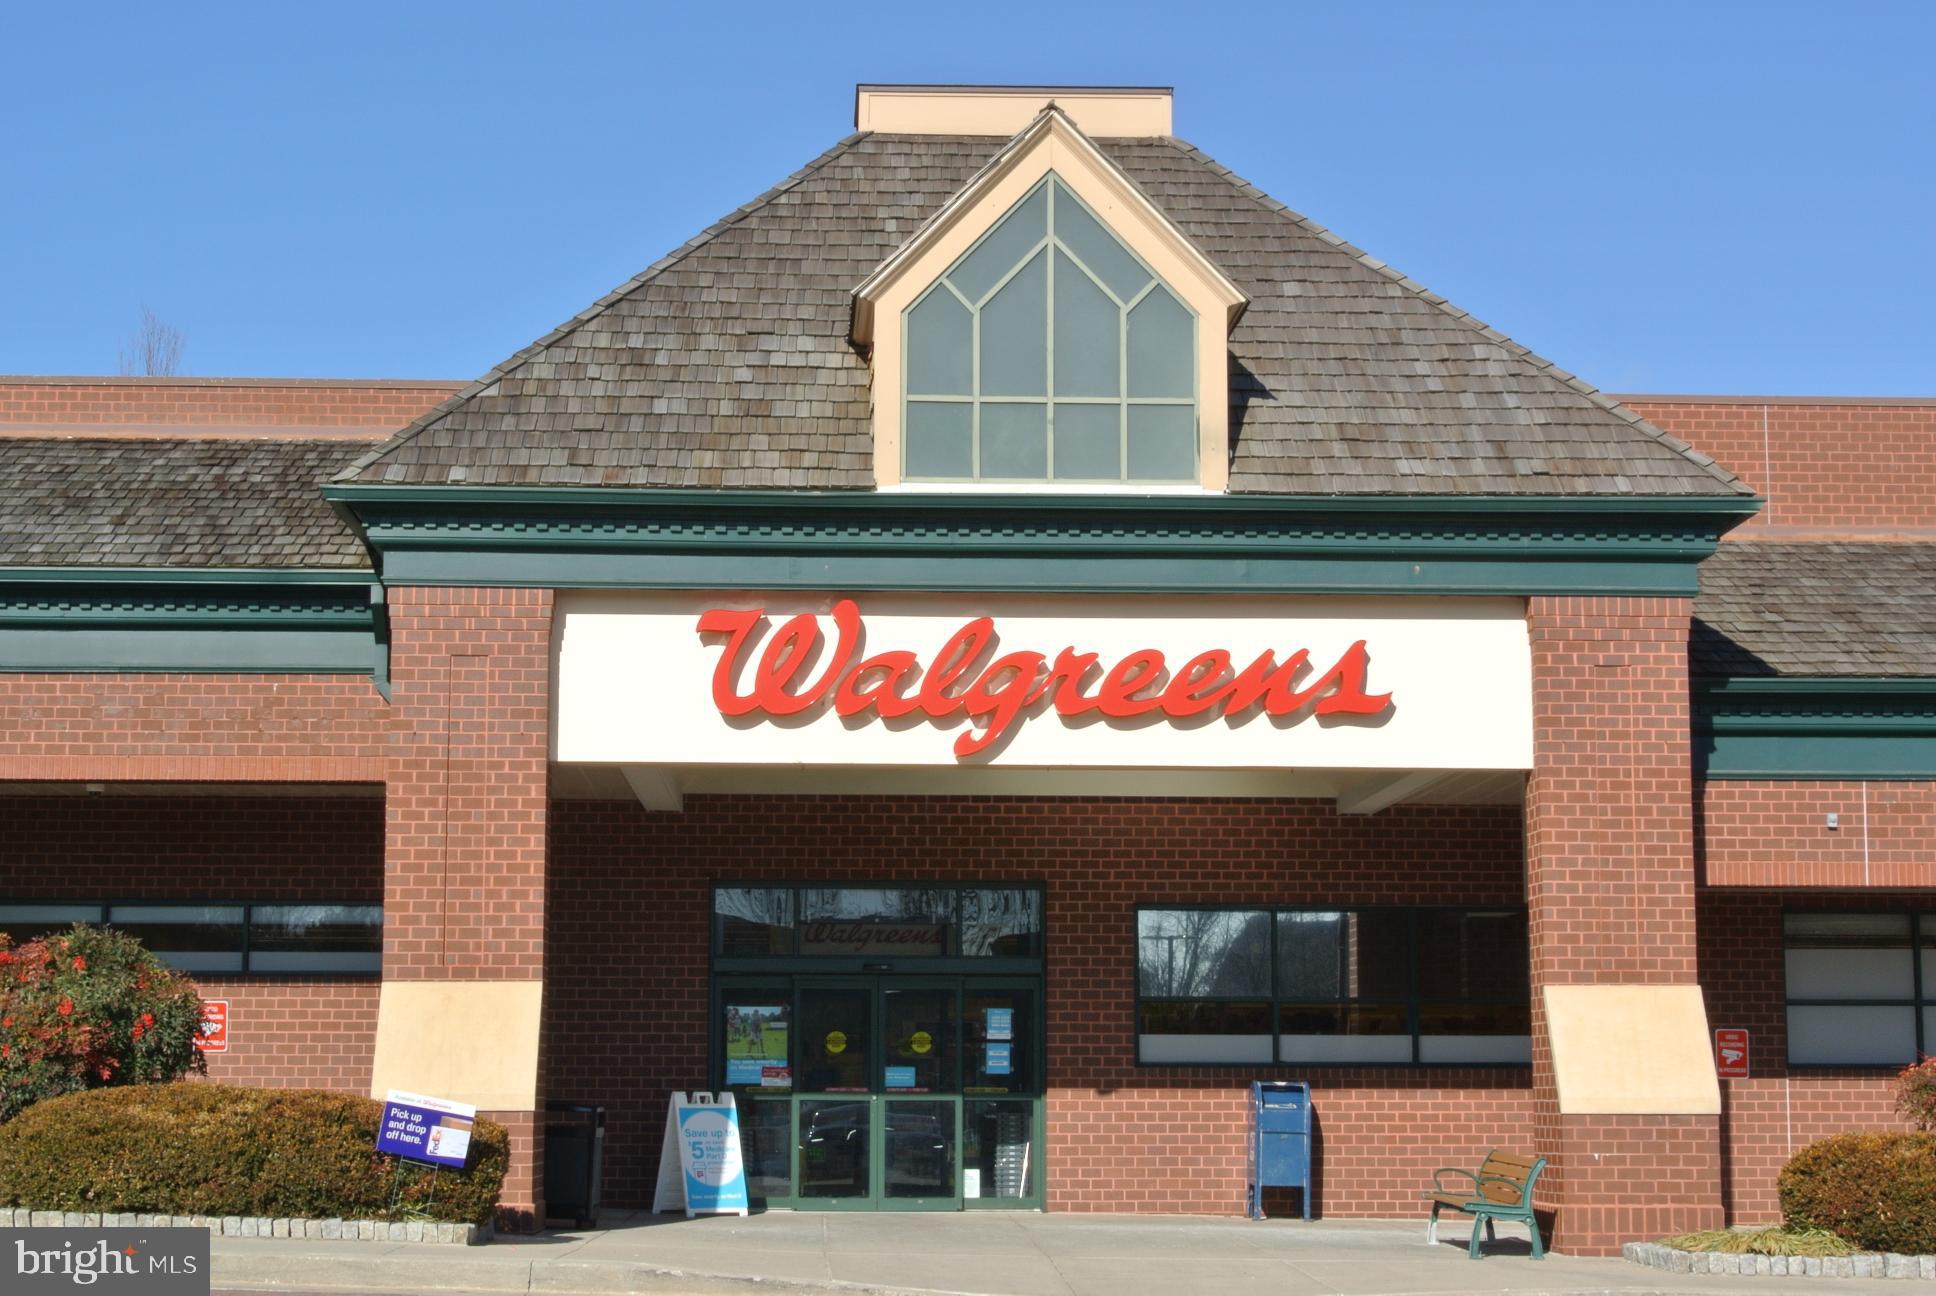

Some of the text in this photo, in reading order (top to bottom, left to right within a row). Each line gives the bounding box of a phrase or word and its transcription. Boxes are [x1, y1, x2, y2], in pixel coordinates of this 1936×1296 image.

[697, 600, 1393, 757] Walgreens
[804, 922, 943, 951] Walgreens
[391, 1107, 423, 1124] Pick up
[388, 1120, 427, 1135] and drop
[685, 1128, 735, 1140] Save up to
[386, 1130, 422, 1144] off here.
[429, 1129, 442, 1154] FedEx
